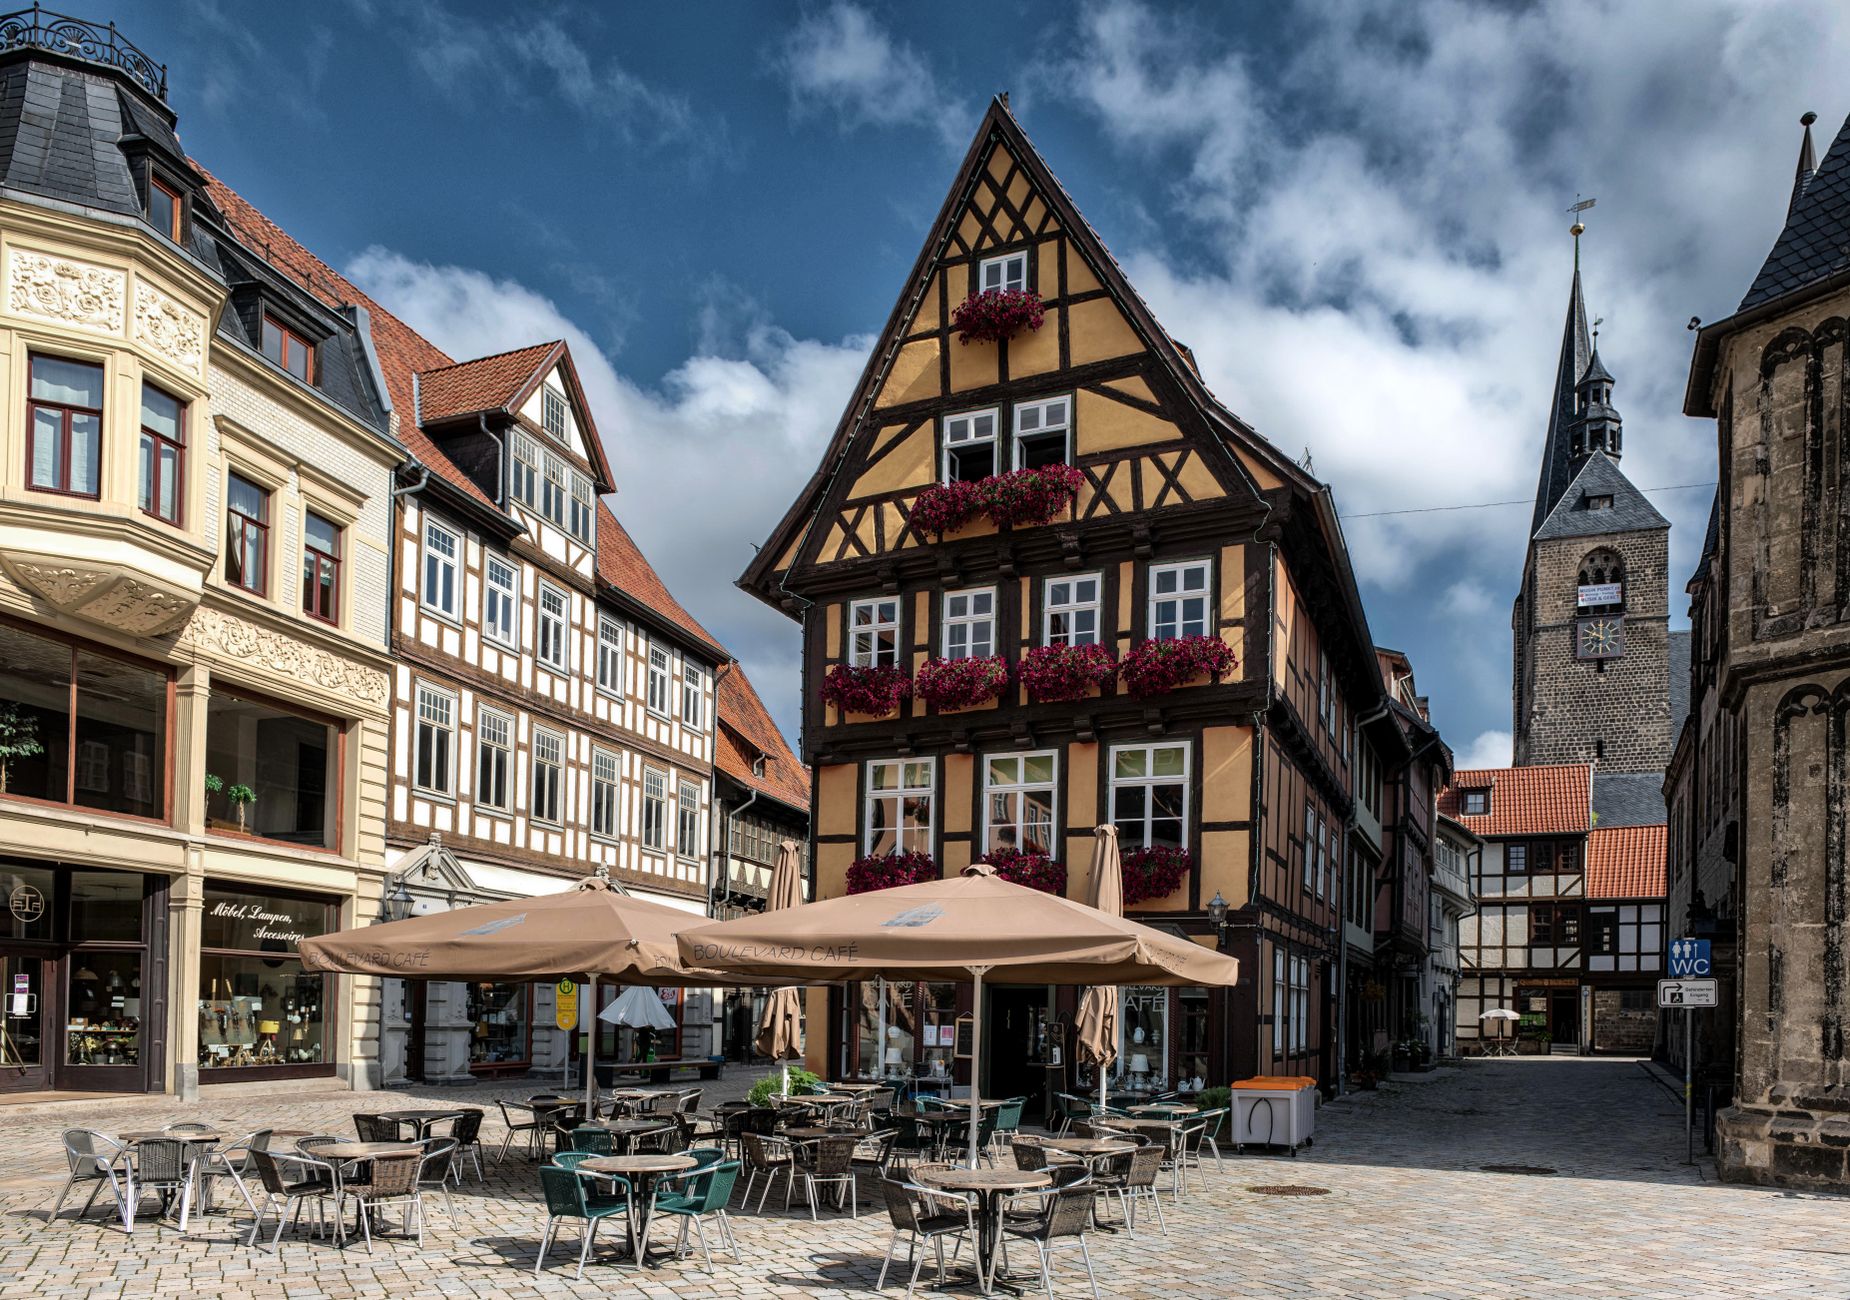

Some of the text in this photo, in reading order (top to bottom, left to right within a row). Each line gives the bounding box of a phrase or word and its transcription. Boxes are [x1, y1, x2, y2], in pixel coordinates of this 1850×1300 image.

[210, 902, 292, 925] Möbel, Lampen,
[393, 948, 431, 967] CAFÉ
[693, 941, 859, 962] BOULEVARD CAFÉ
[1671, 958, 1709, 974] WC
[563, 982, 570, 991] H
[1124, 992, 1166, 1012] AFÉ
